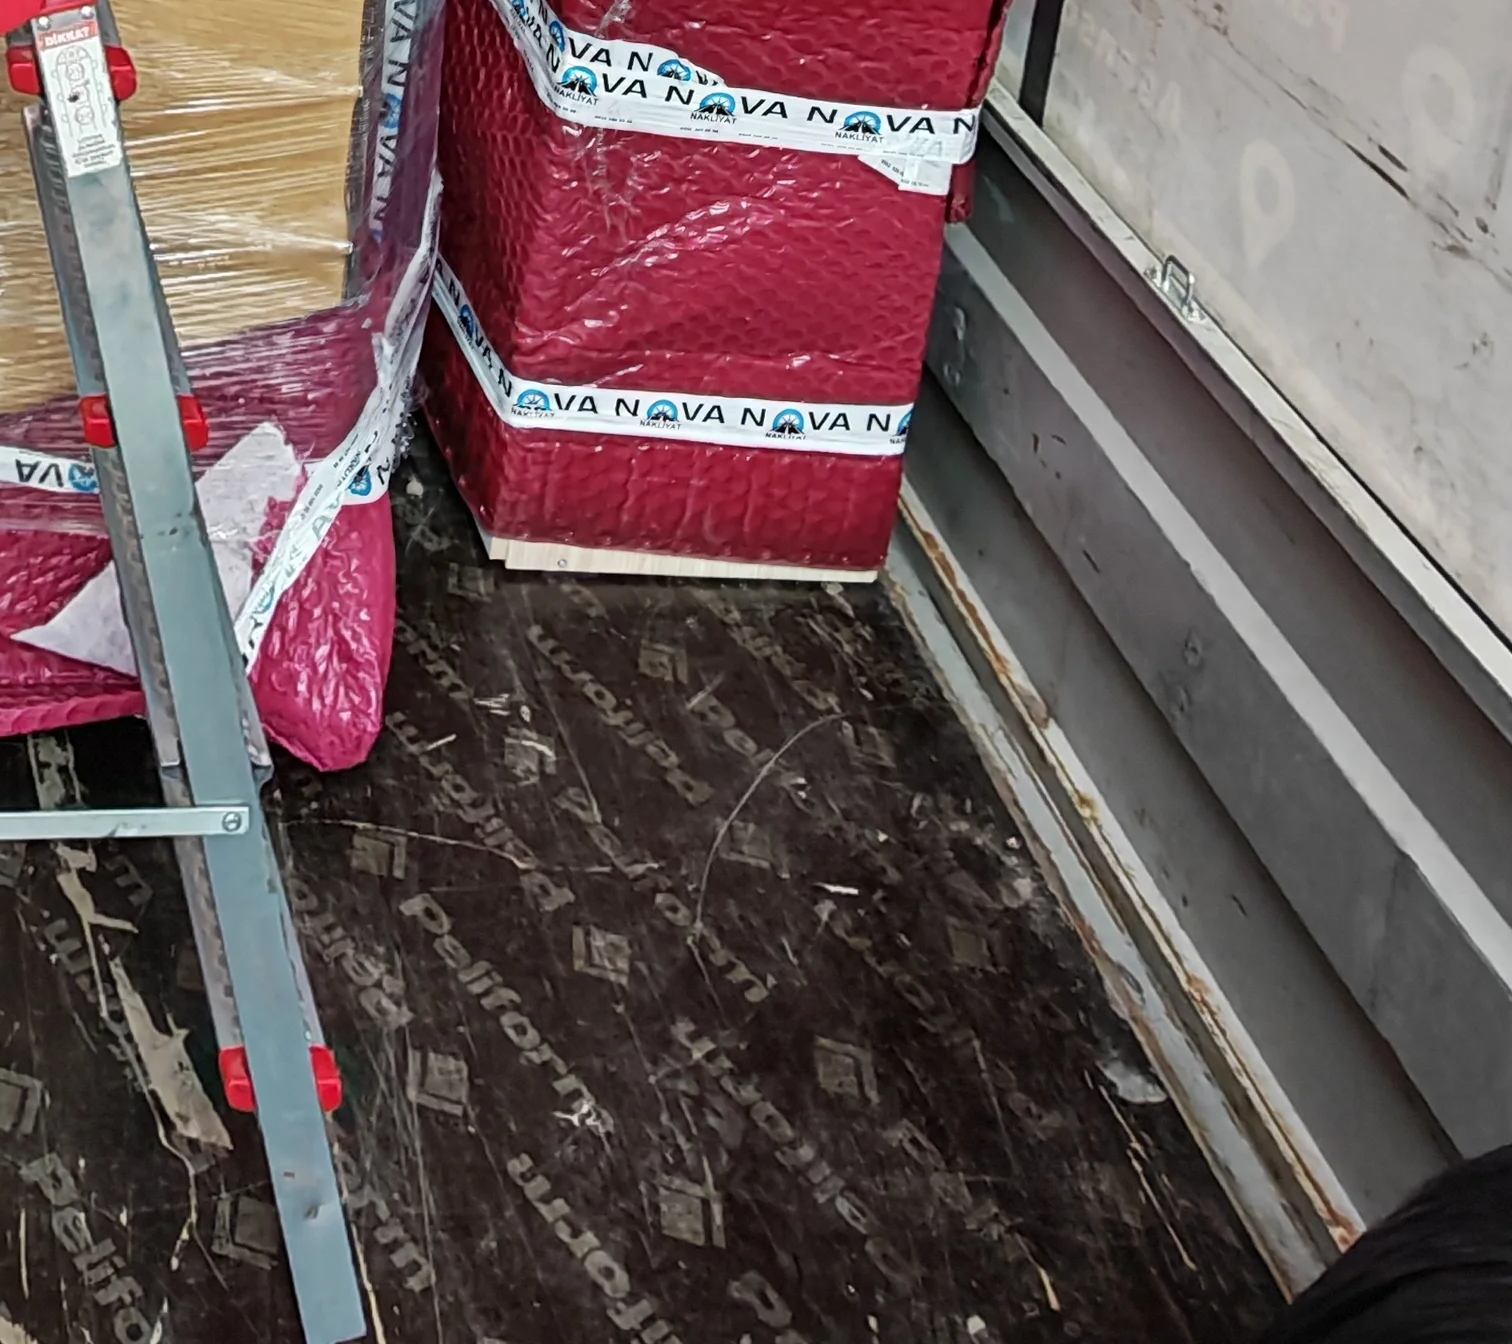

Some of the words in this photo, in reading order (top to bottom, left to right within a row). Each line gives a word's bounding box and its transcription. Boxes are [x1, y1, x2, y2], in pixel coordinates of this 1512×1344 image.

[545, 44, 648, 100] NOVA
[664, 85, 790, 120] NOVA
[806, 105, 937, 136] NOVA
[552, 85, 600, 107] NAKLİYAT
[690, 112, 737, 126] NAKLİYAT
[834, 130, 885, 144] NAKLİYAT
[497, 368, 600, 416] NOVA
[614, 397, 726, 425] NOVA
[739, 407, 852, 434] NOVA
[638, 420, 682, 432] NAKLİYAT
